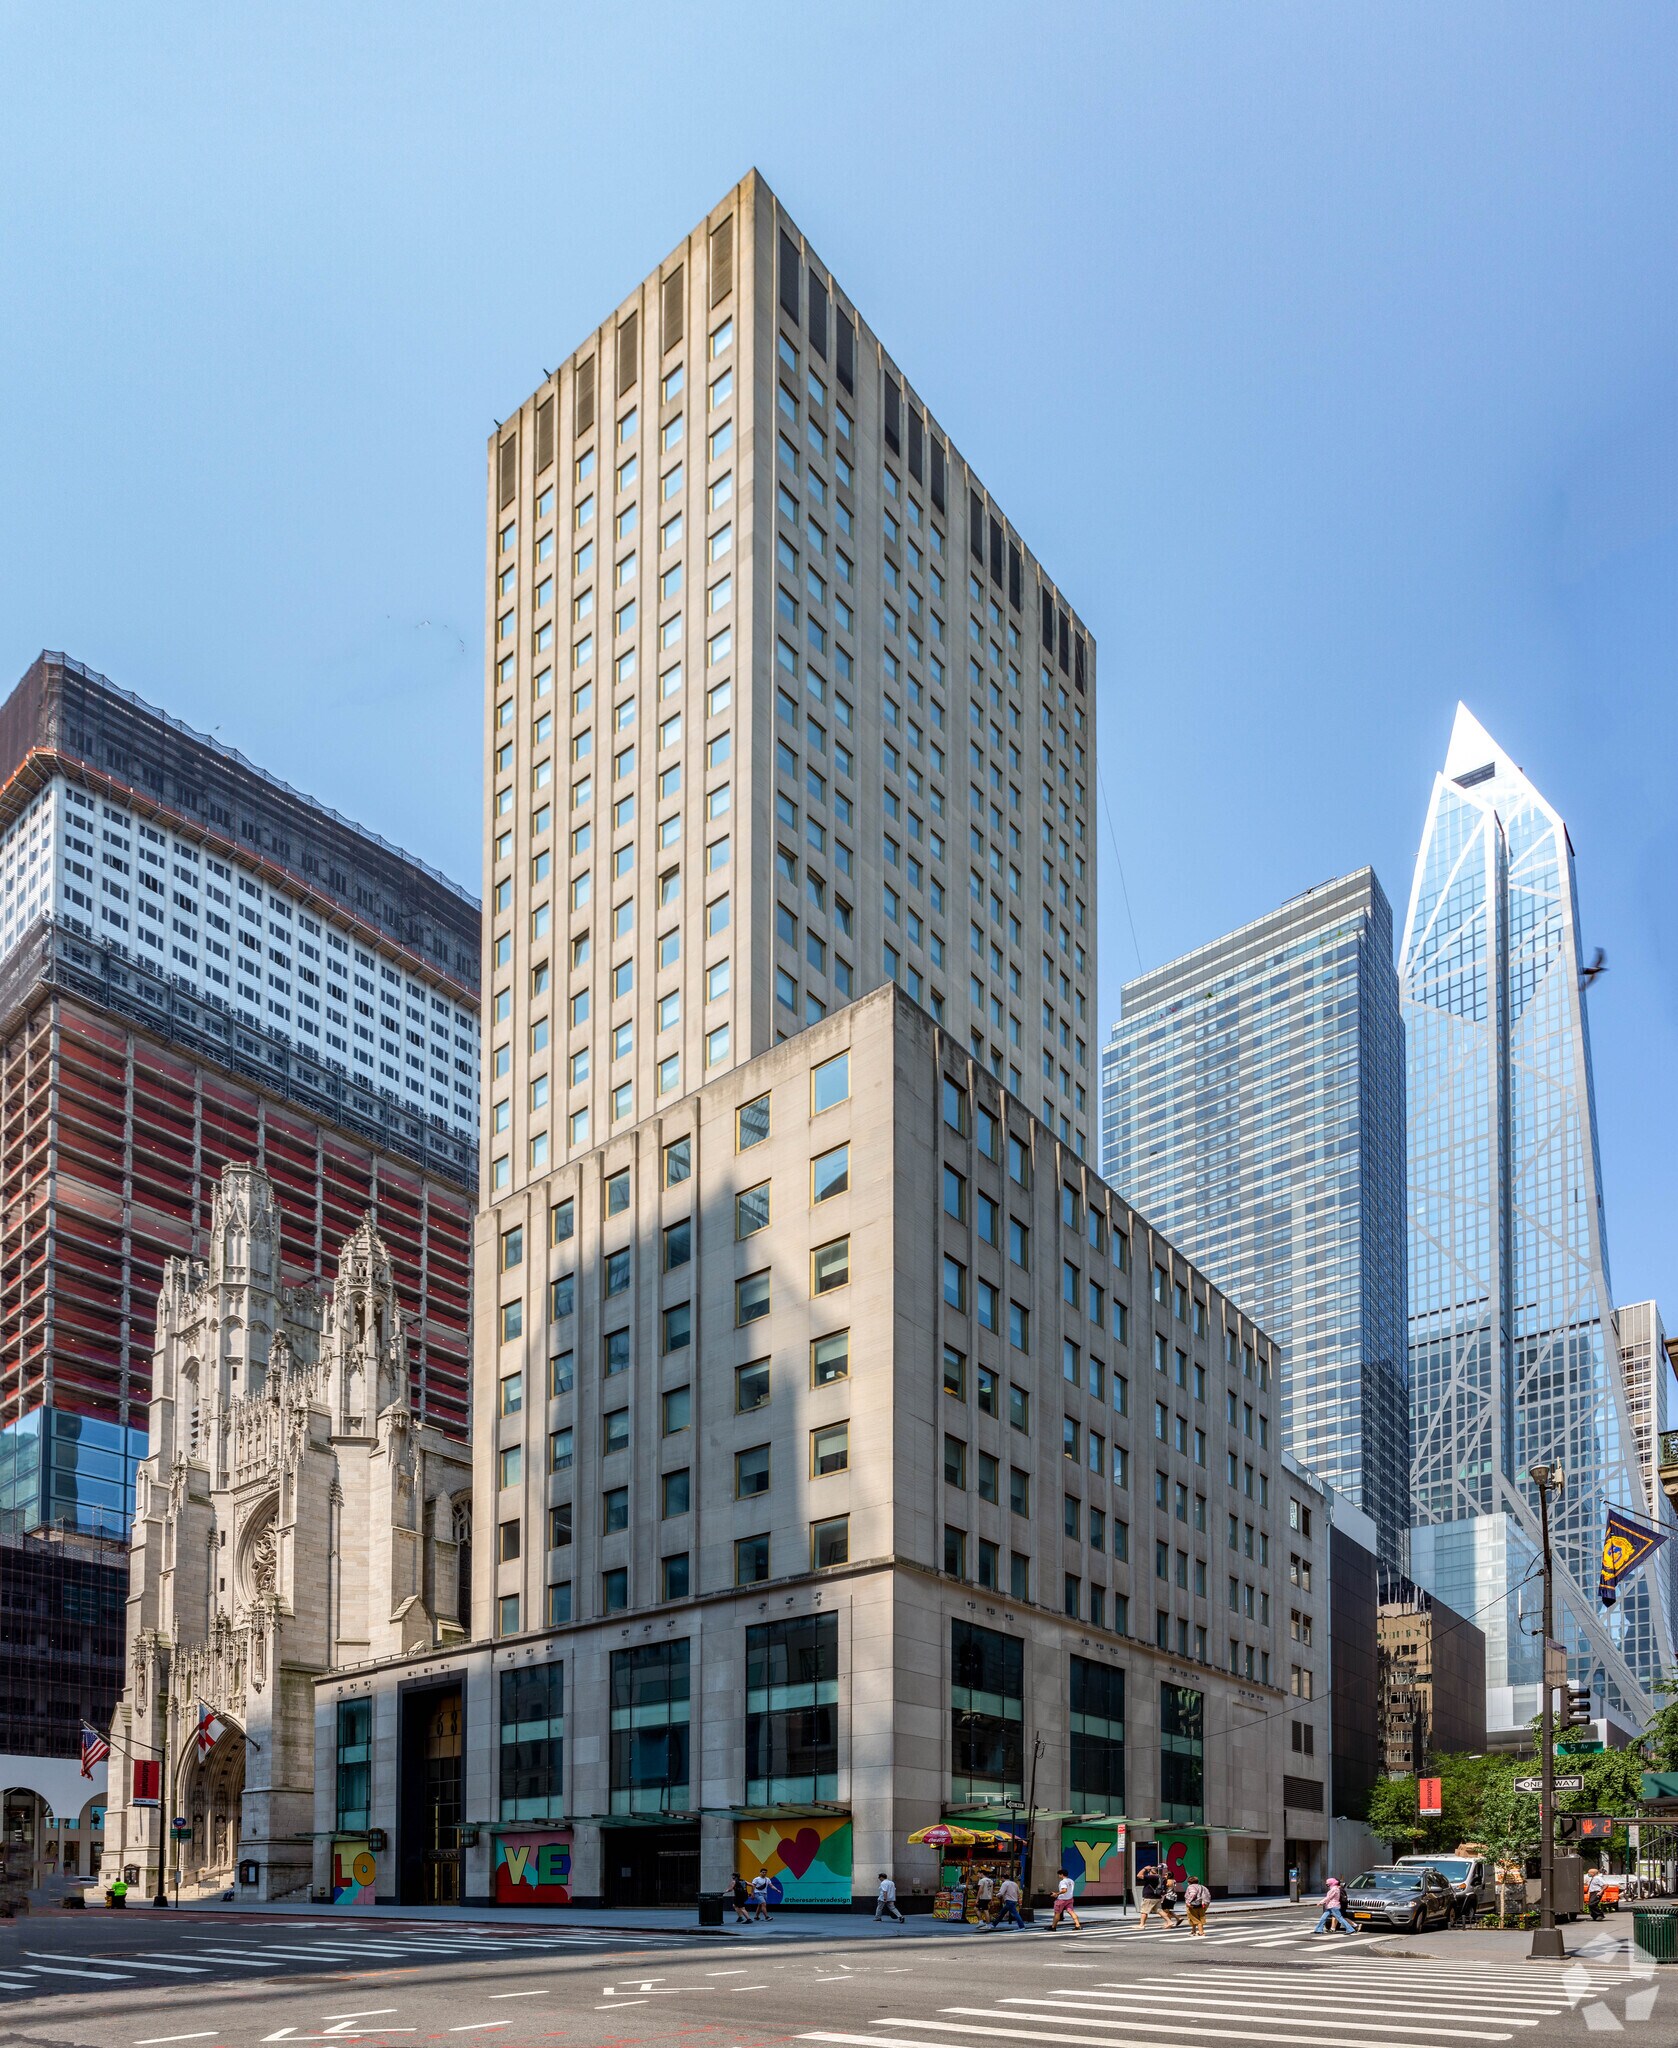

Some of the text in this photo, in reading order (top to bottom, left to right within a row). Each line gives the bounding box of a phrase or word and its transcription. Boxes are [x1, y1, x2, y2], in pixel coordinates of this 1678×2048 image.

[1570, 1744, 1576, 1753] 5
[141, 1760, 150, 1796] Automania
[1603, 1819, 1611, 1833] 2
[334, 1844, 570, 1887] LO VE
[1074, 1840, 1188, 1883] Y C
